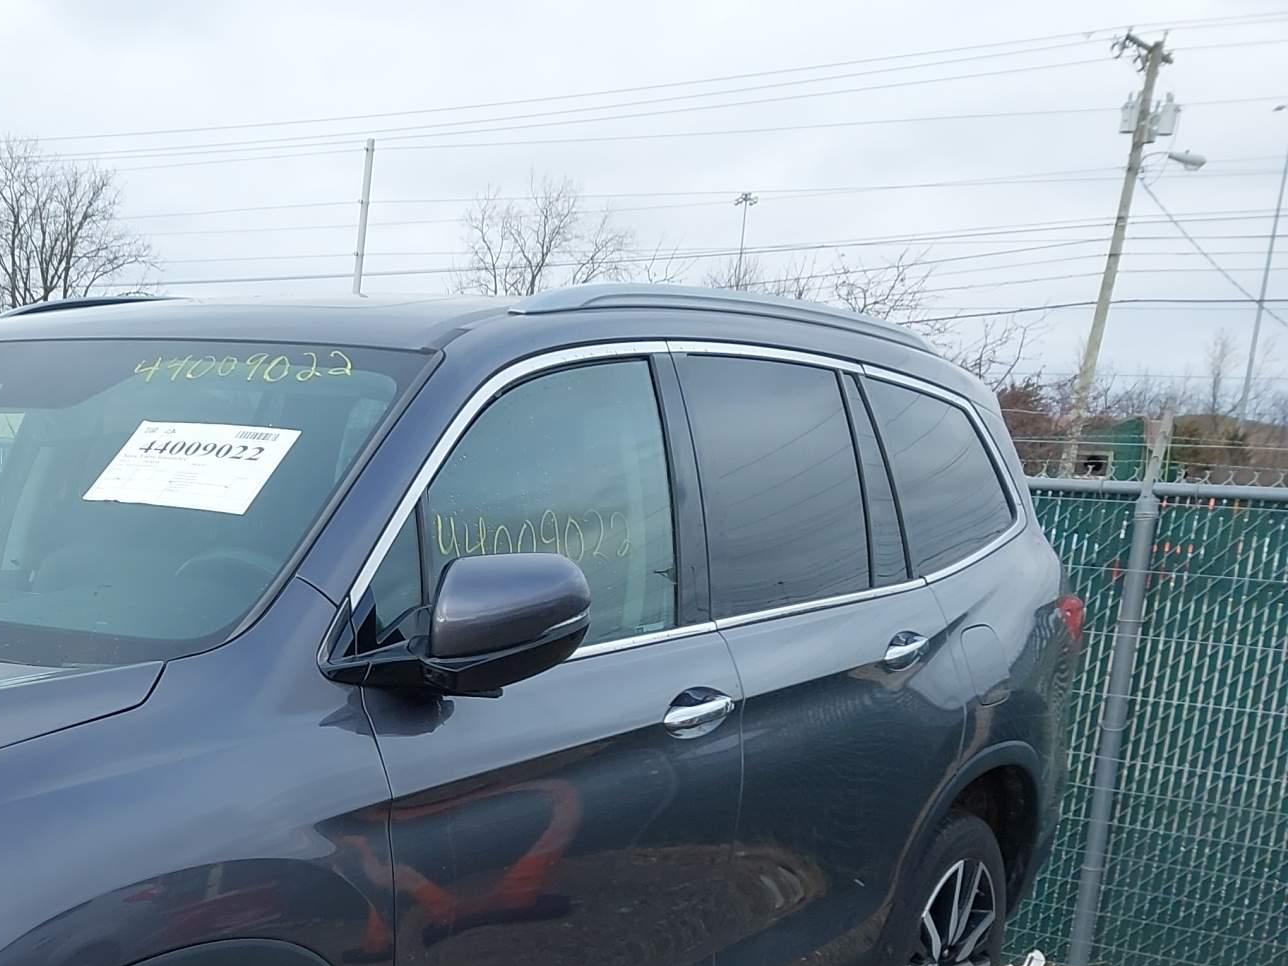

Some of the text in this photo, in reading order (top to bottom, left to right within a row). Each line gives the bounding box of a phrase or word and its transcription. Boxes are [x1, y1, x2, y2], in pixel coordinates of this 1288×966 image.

[134, 350, 353, 382] 44009022
[138, 439, 266, 462] 44009022
[436, 509, 632, 563] 44009022
